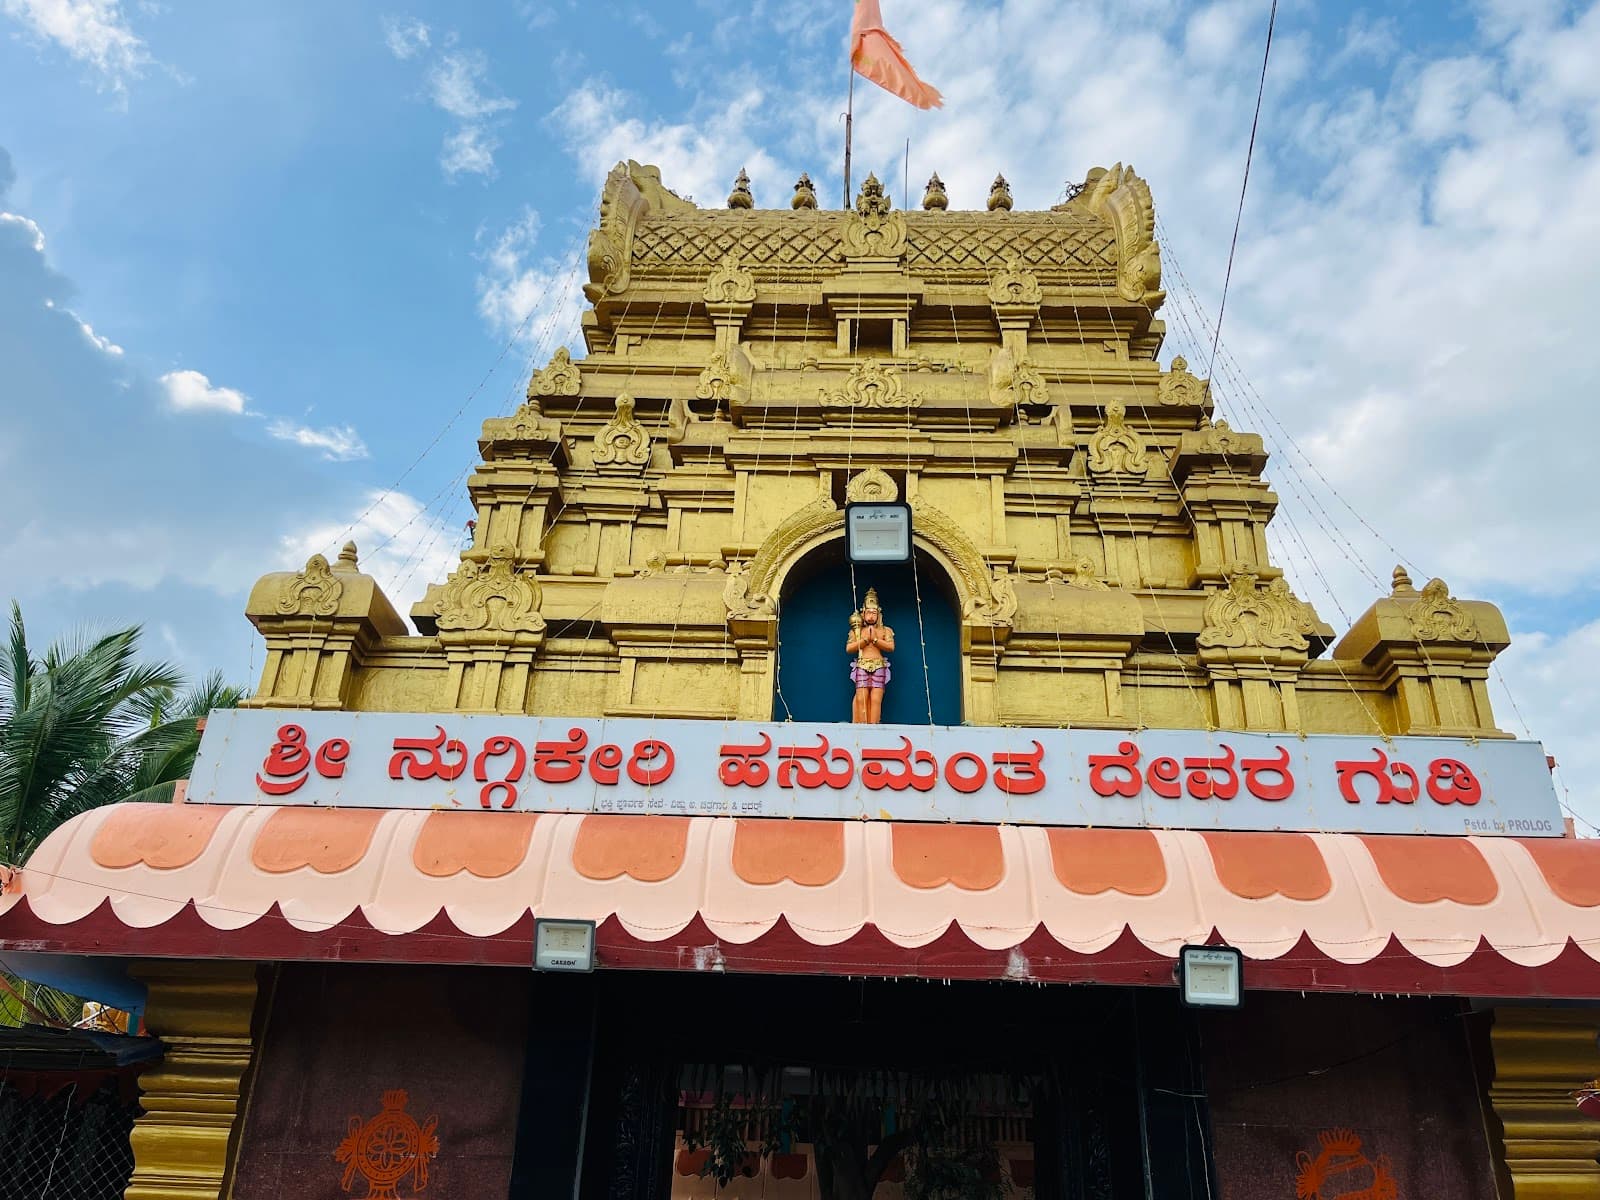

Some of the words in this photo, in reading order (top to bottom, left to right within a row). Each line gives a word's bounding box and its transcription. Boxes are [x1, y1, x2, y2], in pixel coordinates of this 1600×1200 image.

[255, 724, 350, 795] ಶ್ರೀ
[387, 725, 676, 809] ನುಗ್ಗಿಕೇರಿ
[718, 731, 1047, 795] ಹನುಮಂತ
[1087, 741, 1295, 802] ದೇವರ
[1335, 748, 1482, 805] ಗುಡಿ
[1508, 819, 1552, 832] PROLOG
